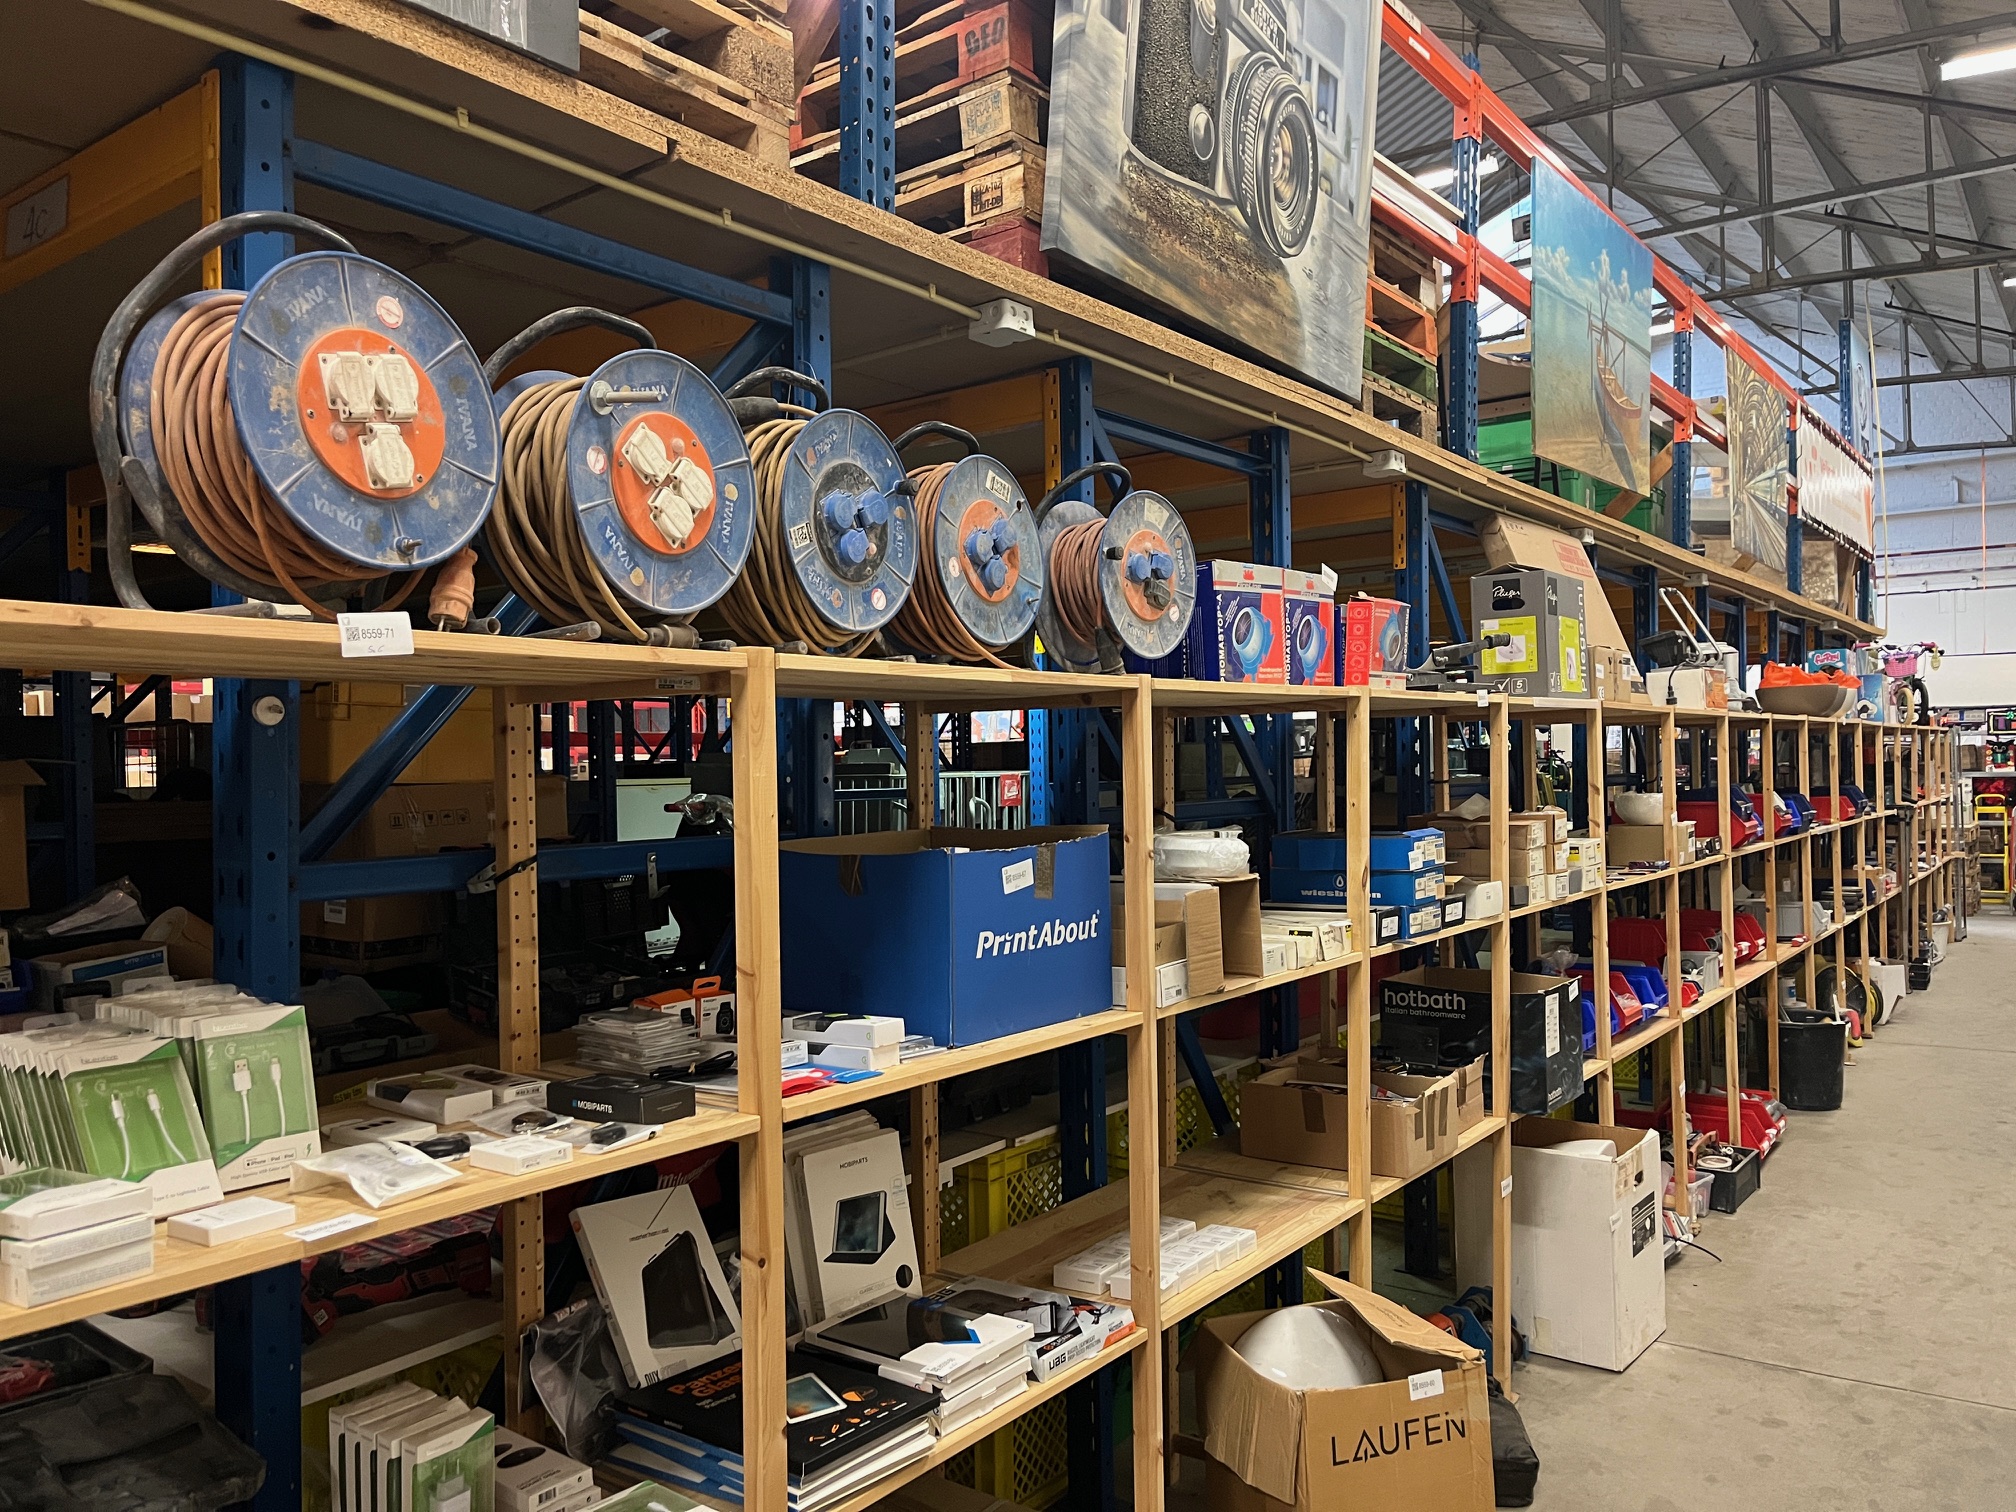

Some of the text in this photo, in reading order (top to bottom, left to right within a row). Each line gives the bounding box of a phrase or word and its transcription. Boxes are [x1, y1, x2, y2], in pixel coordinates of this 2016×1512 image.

[1250, 6, 1271, 39] SUPER
[285, 284, 328, 323] IVANA
[455, 397, 478, 452] IVANA
[605, 525, 634, 571] IVANA
[1175, 548, 1187, 583] IVANA
[361, 627, 395, 640] 8559-71
[976, 913, 1099, 959] PrintAbout
[1384, 988, 1466, 1011] hotbath
[1409, 1008, 1466, 1020] bathroomware
[578, 1100, 613, 1114] MOBIPARTS
[839, 1156, 869, 1170] MOBIPARTS
[1331, 1411, 1467, 1467] LAUFEN
